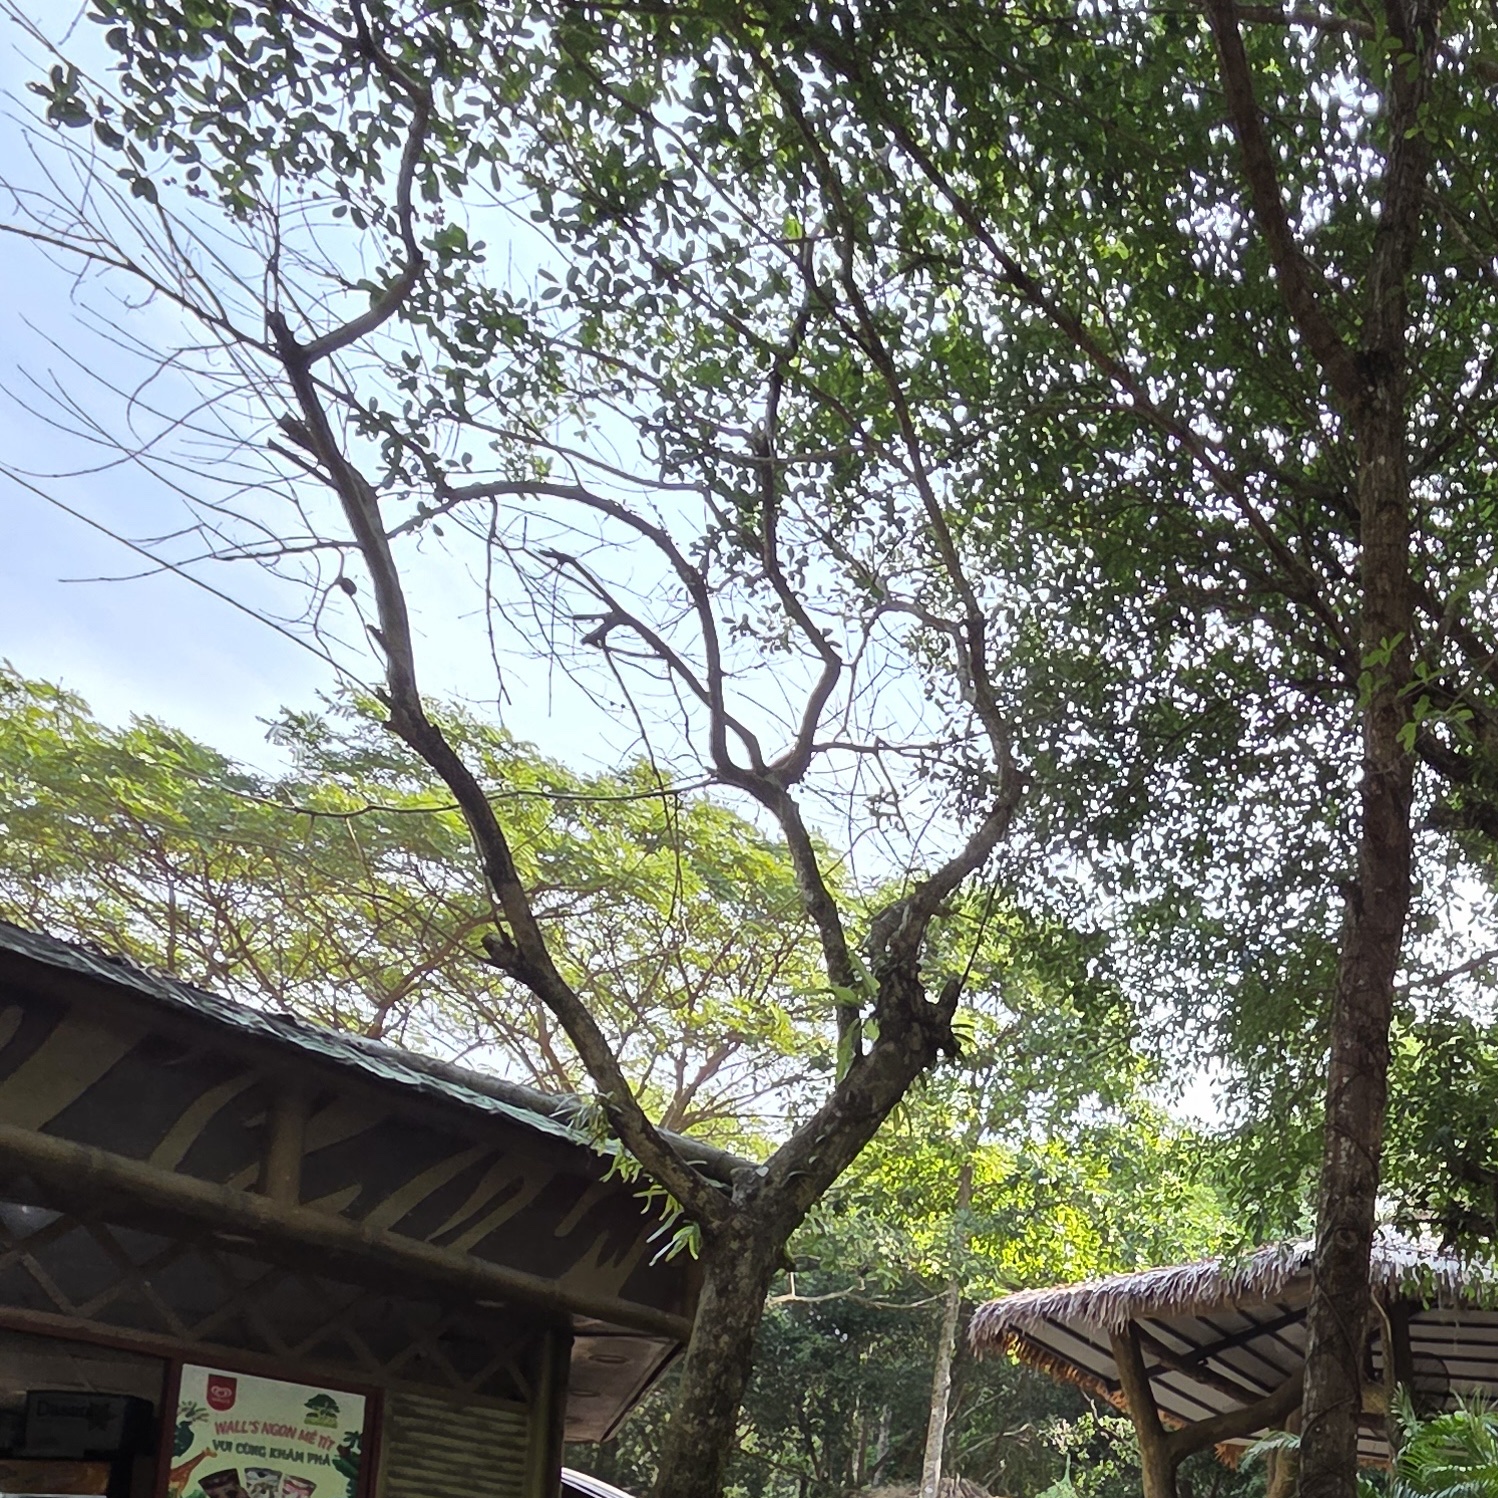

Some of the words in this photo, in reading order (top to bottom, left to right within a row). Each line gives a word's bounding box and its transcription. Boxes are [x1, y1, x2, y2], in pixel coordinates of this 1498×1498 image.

[214, 1420, 259, 1435] WALL'S
[262, 1422, 297, 1439] NGON
[212, 1439, 233, 1452] VUI
